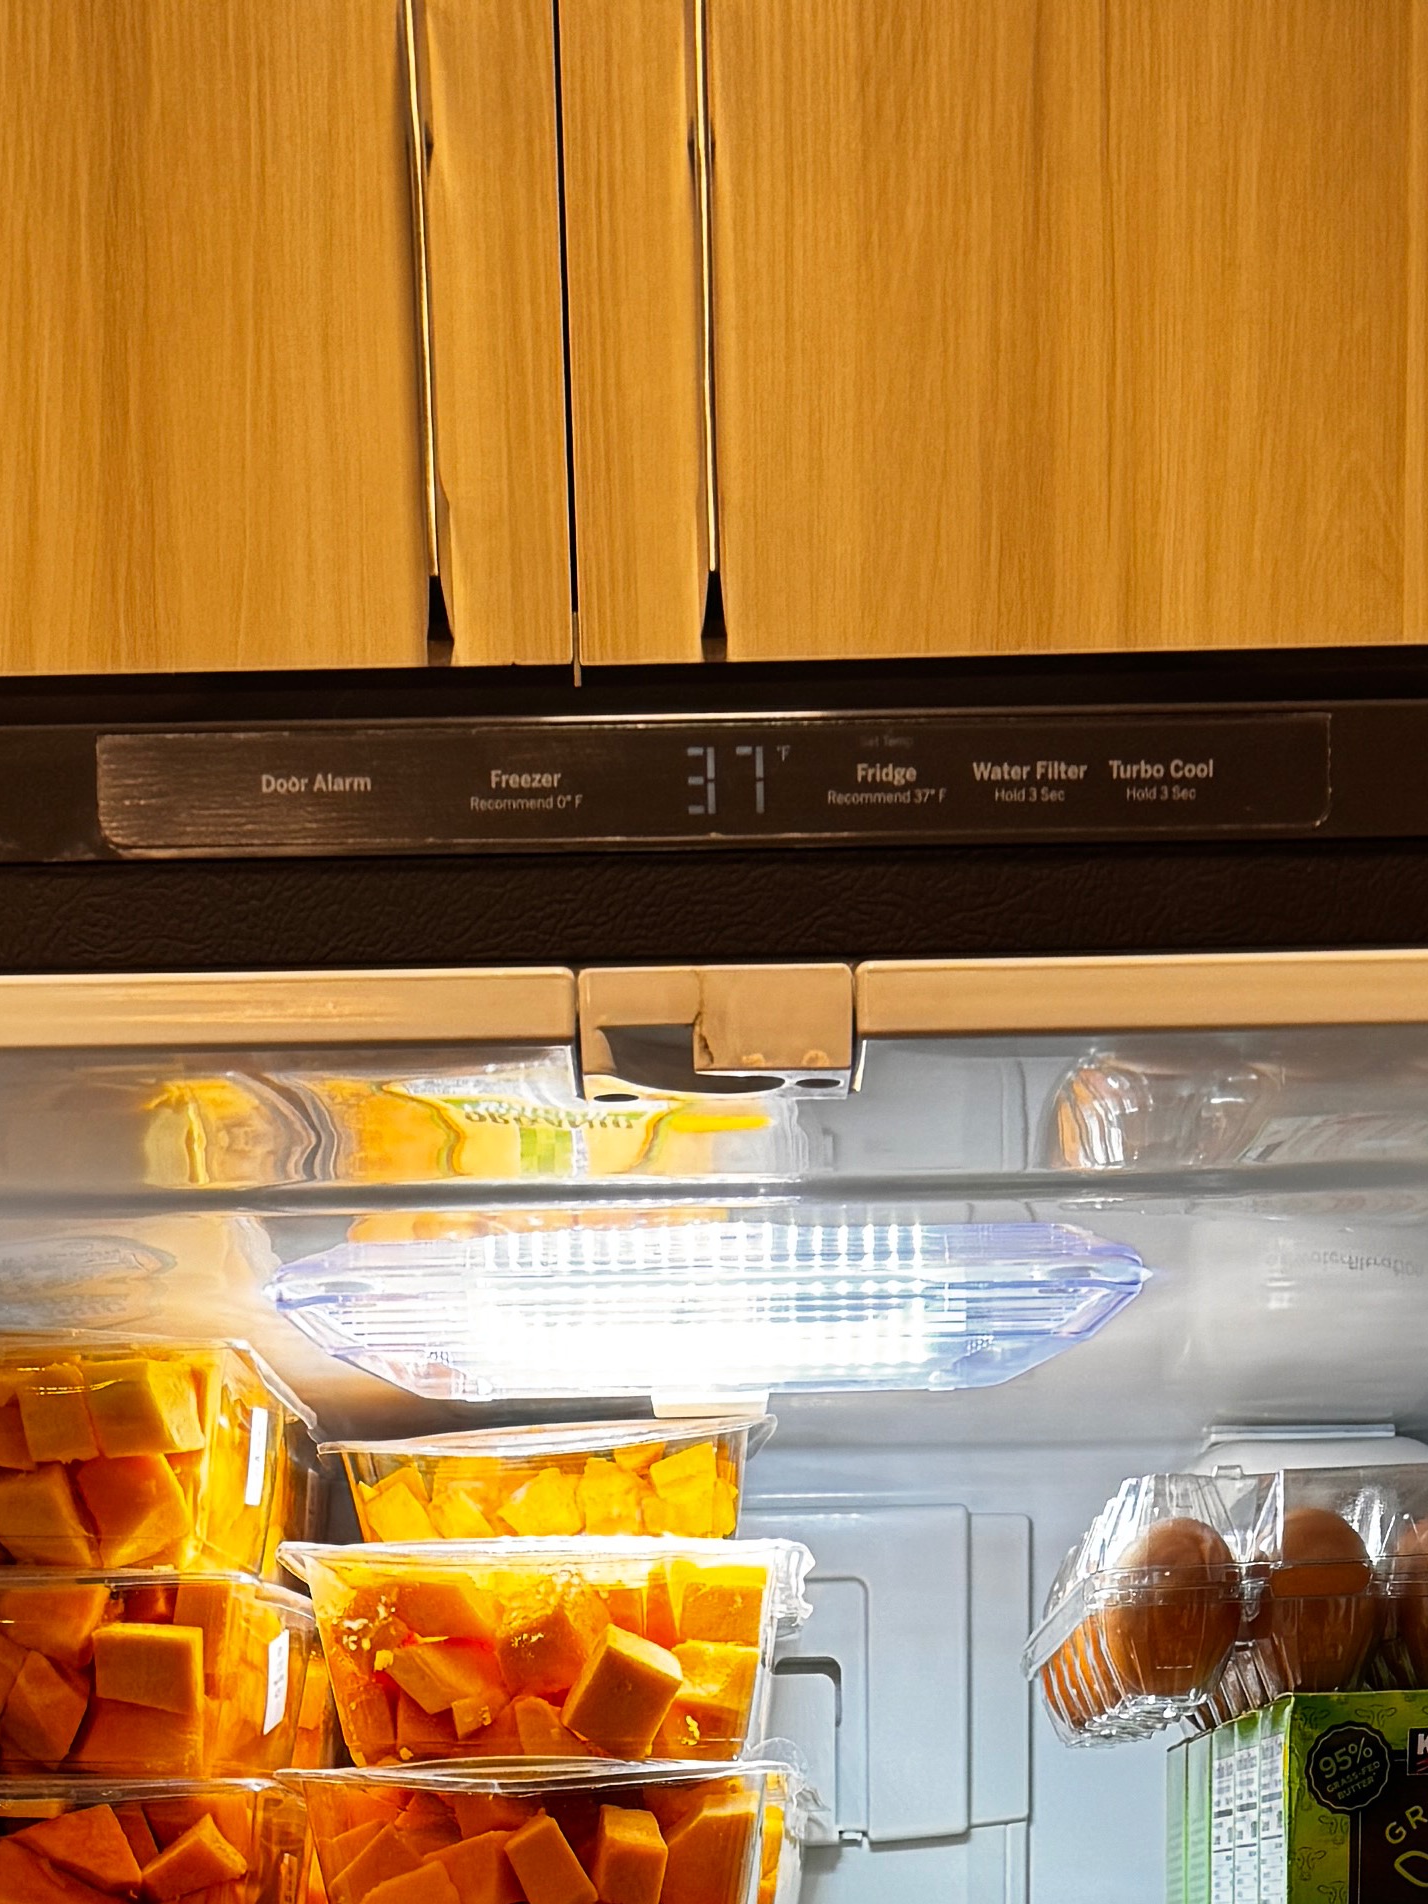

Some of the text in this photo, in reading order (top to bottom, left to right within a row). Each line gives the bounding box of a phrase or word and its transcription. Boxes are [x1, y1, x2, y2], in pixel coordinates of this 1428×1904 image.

[490, 770, 562, 789] Freezer
[856, 763, 917, 786] Fridge
[972, 760, 1088, 781] Water Filter
[1108, 758, 1214, 780] Turbo Cool
[261, 773, 372, 794] Door Alarm
[687, 746, 765, 814] 37
[828, 789, 911, 805] Recommend
[914, 788, 935, 803] 37°
[995, 786, 1065, 802] Hold 3 Sec
[1126, 785, 1197, 800] Hold 3 Sec
[470, 795, 554, 812] Recommend
[1318, 1737, 1374, 1780] 95%
[1326, 1761, 1381, 1794] GRASS-FED
